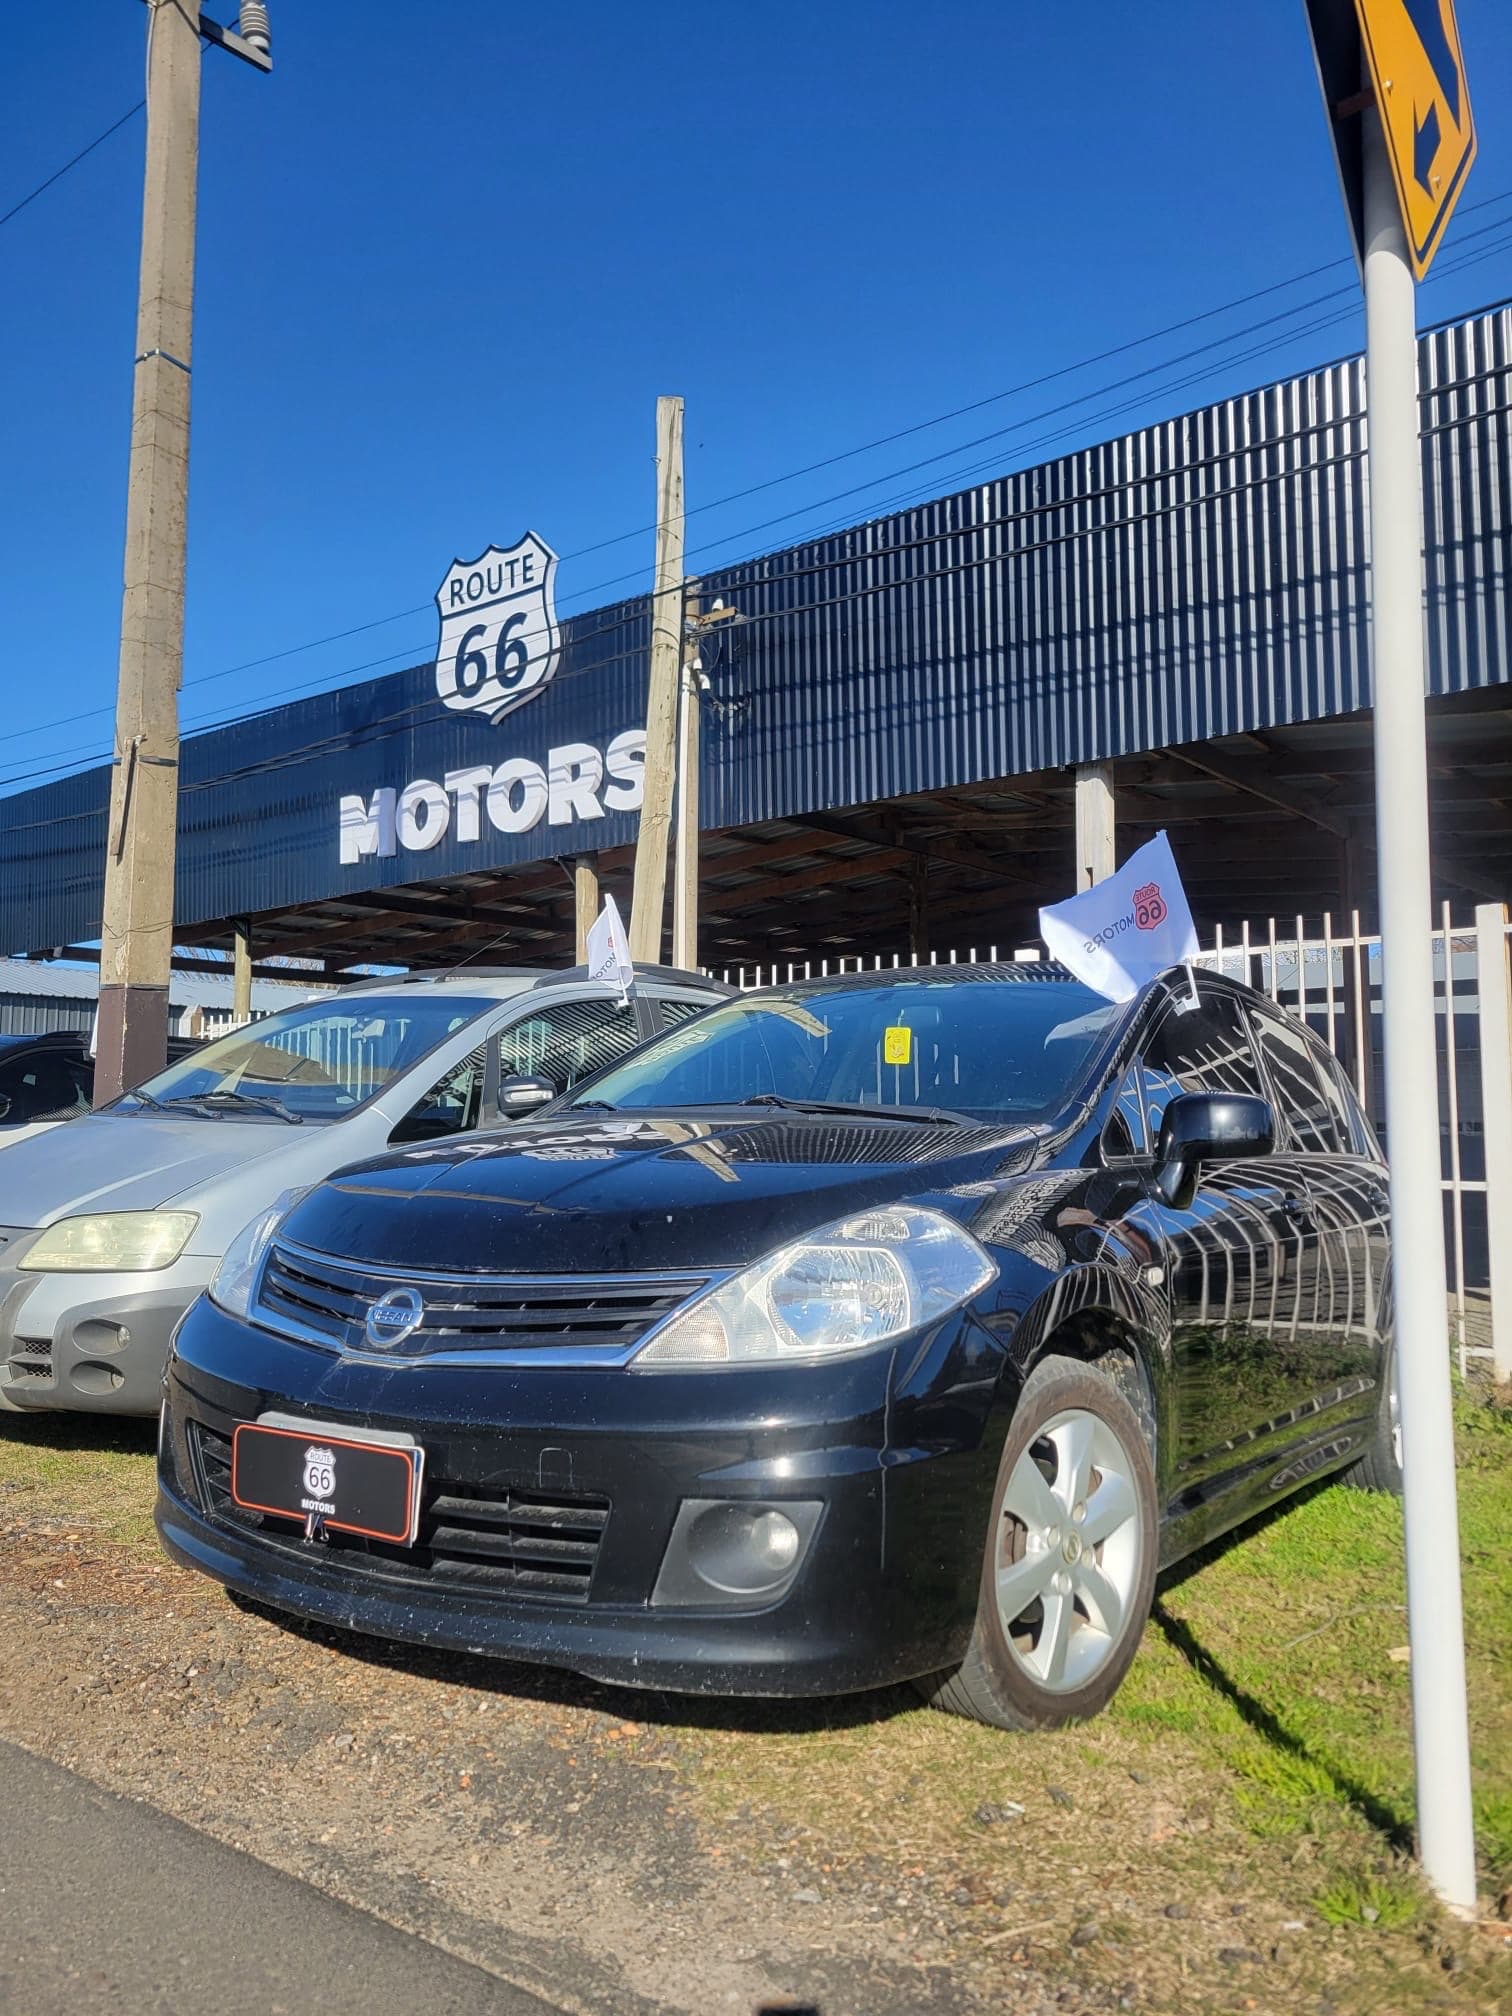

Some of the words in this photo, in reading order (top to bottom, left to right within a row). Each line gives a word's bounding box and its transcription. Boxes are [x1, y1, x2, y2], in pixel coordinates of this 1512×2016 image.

[450, 552, 535, 608] ROUTE
[455, 612, 528, 699] 66
[339, 730, 648, 865] MOTORS
[309, 1466, 331, 1490] 66
[301, 1498, 336, 1515] MOTORS
